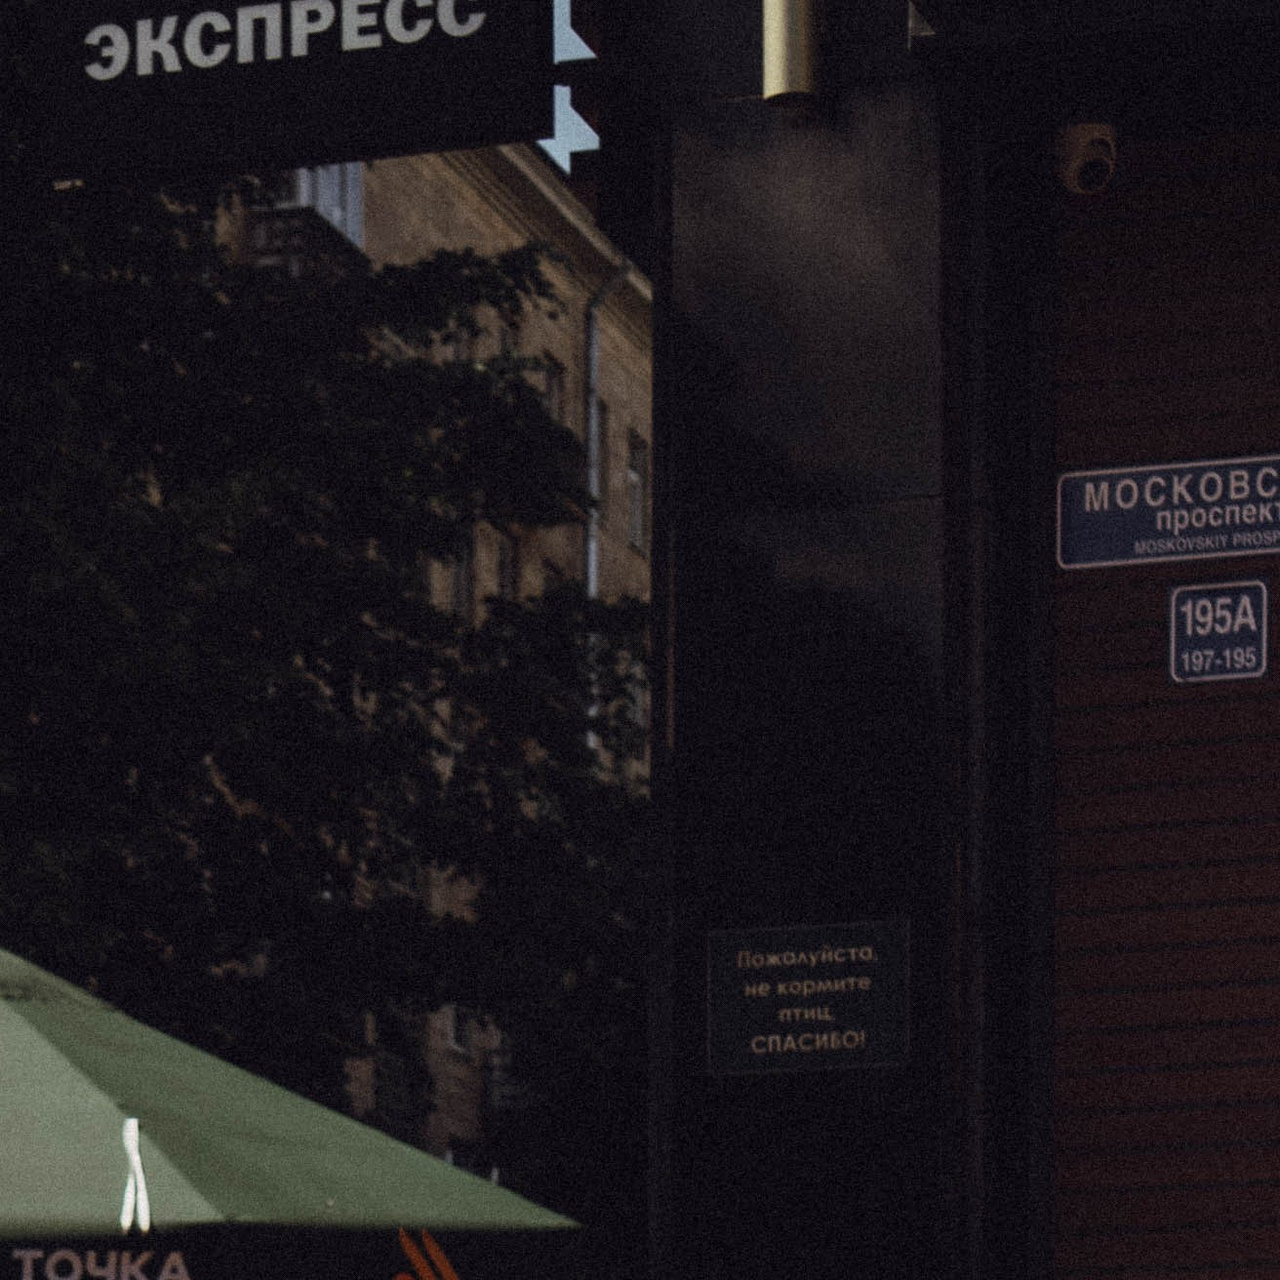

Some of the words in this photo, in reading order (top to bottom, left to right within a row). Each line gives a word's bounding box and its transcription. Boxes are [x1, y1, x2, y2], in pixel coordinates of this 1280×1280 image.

[83, 0, 486, 81] ЭКСПРЕСС
[1084, 467, 1279, 512] МОСКОВС
[1134, 534, 1228, 554] MOSKOVSKIY
[1180, 594, 1257, 637] 195А
[1181, 648, 1256, 672] 197-195
[744, 982, 770, 997] не
[777, 976, 872, 998] кормите
[750, 1029, 867, 1054] СПАСИБО!
